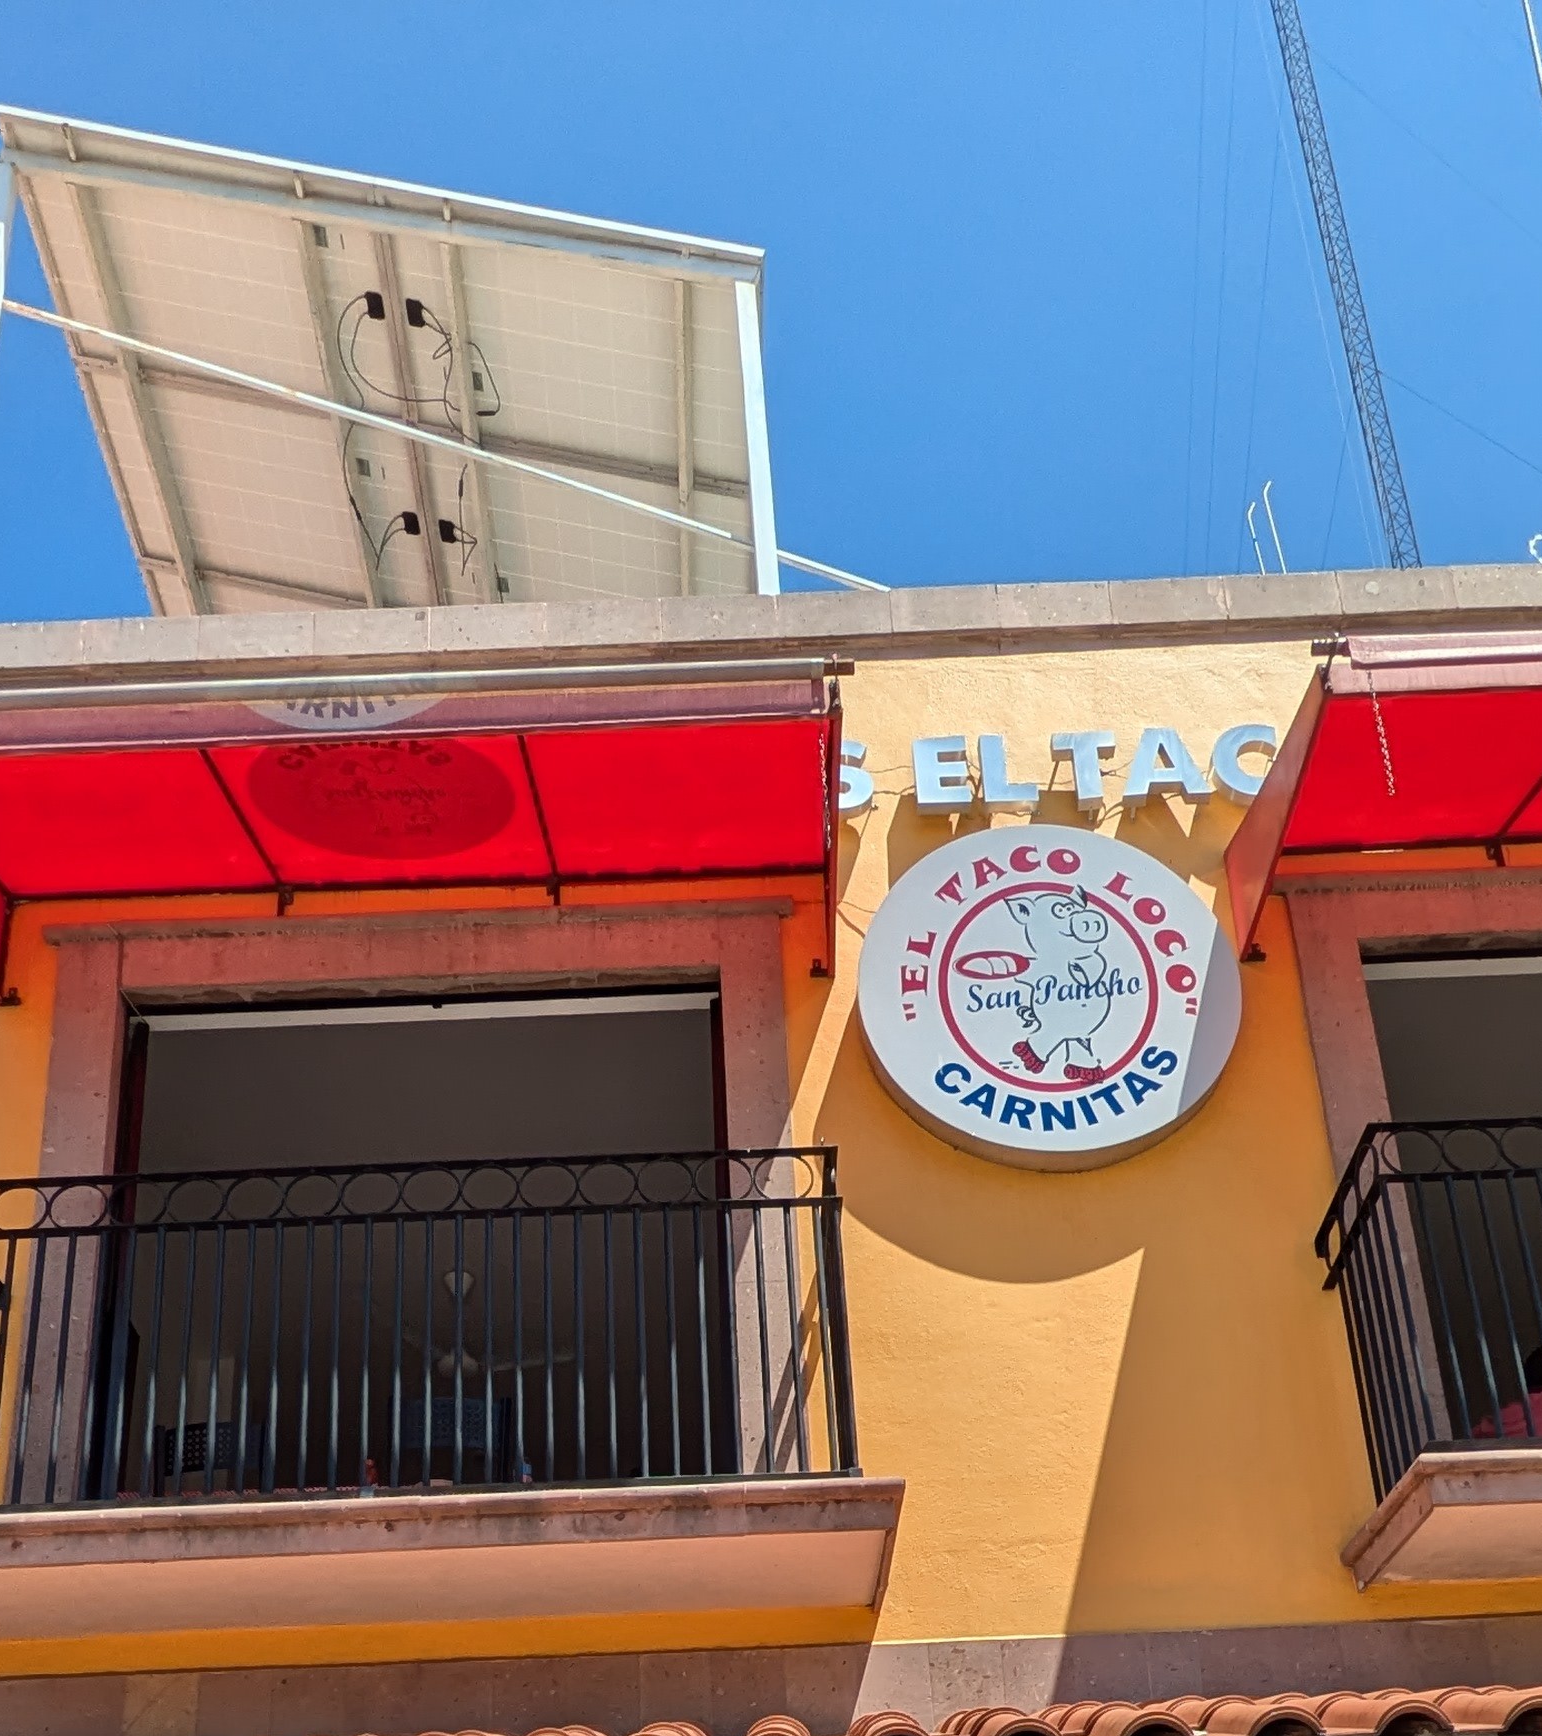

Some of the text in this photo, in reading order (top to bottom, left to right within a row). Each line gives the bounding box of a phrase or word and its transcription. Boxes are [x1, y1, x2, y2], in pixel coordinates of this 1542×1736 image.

[913, 734, 1039, 813] EL
[1051, 724, 1277, 818] TAC
[935, 844, 1081, 907] TACO
[966, 967, 1144, 1014] San Pancho
[935, 1044, 1179, 1132] CARNITAS
